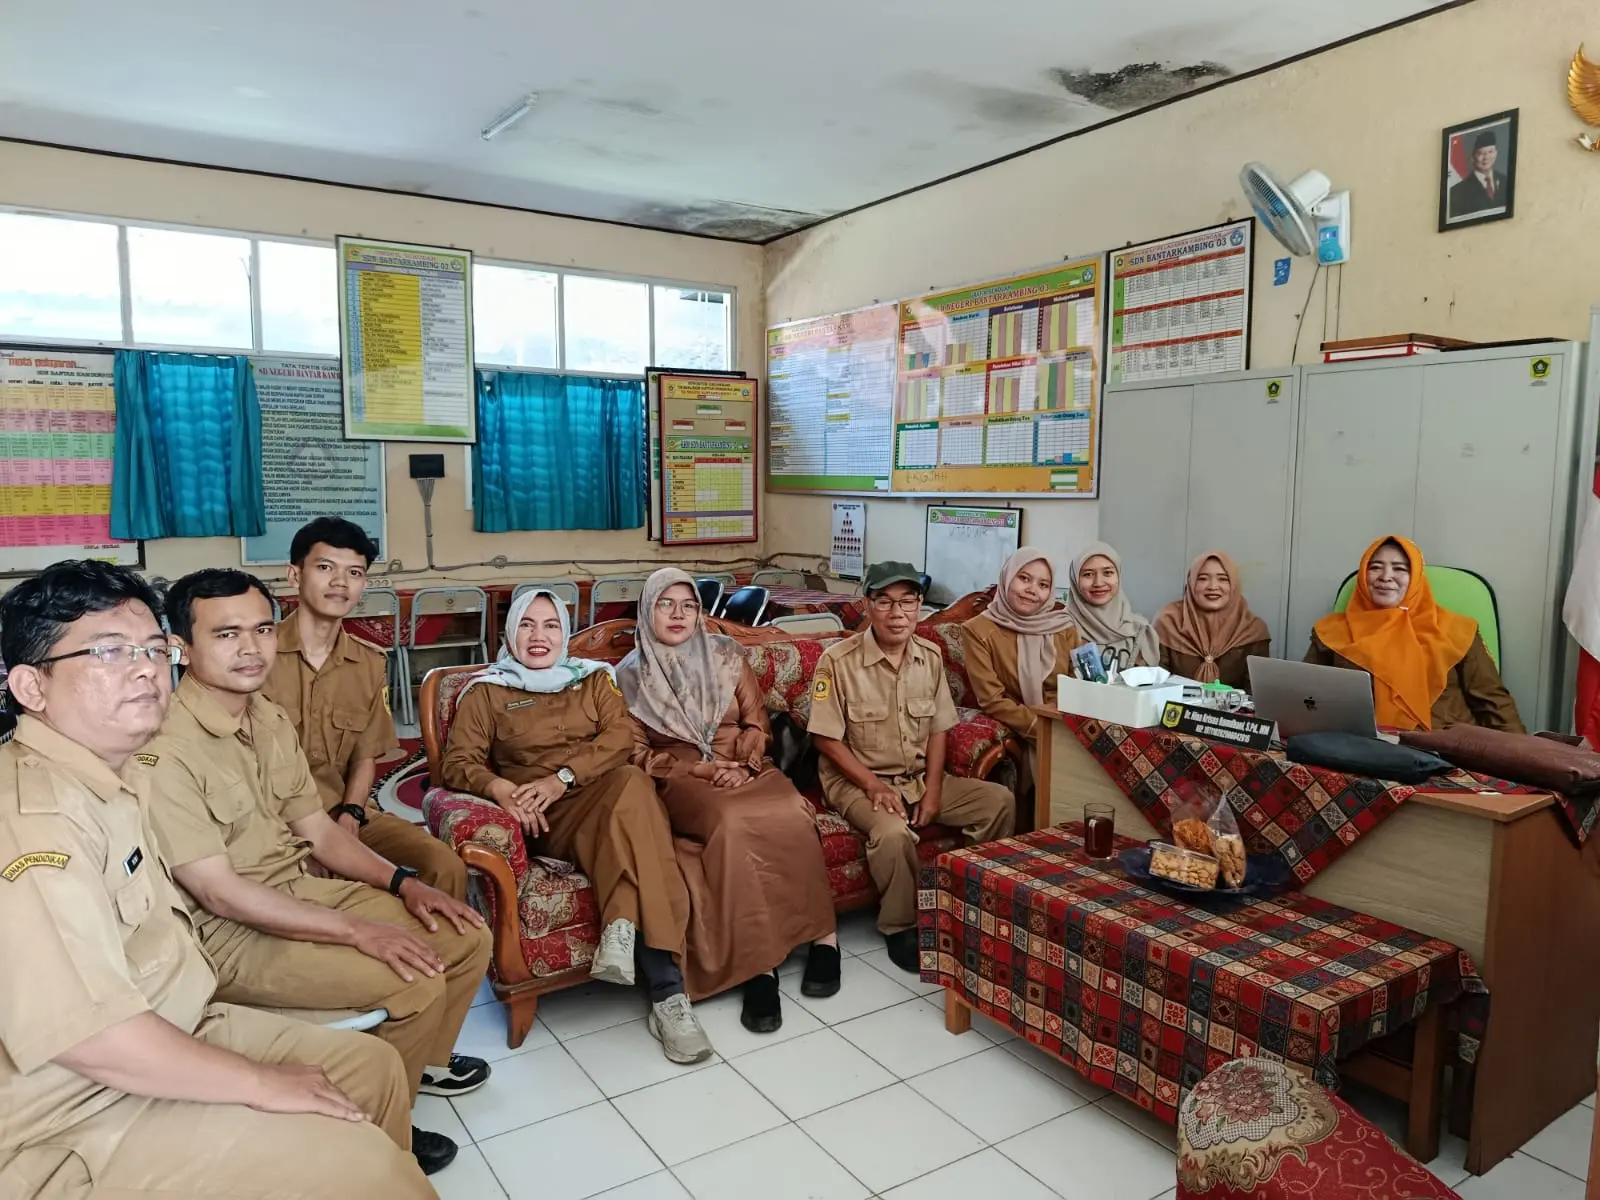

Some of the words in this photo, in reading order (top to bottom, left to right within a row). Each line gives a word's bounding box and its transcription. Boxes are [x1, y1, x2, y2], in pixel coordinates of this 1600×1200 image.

[1130, 256, 1144, 265] SDN
[1147, 240, 1214, 262] BANTARKAMBING
[1216, 237, 1227, 246] 03
[946, 299, 973, 311] NEGERI
[974, 287, 1038, 307] BANTARKAMBING
[296, 370, 321, 378] BANTAR
[5, 861, 25, 878] DINAS
[24, 854, 66, 866] PENDIDIKAN
